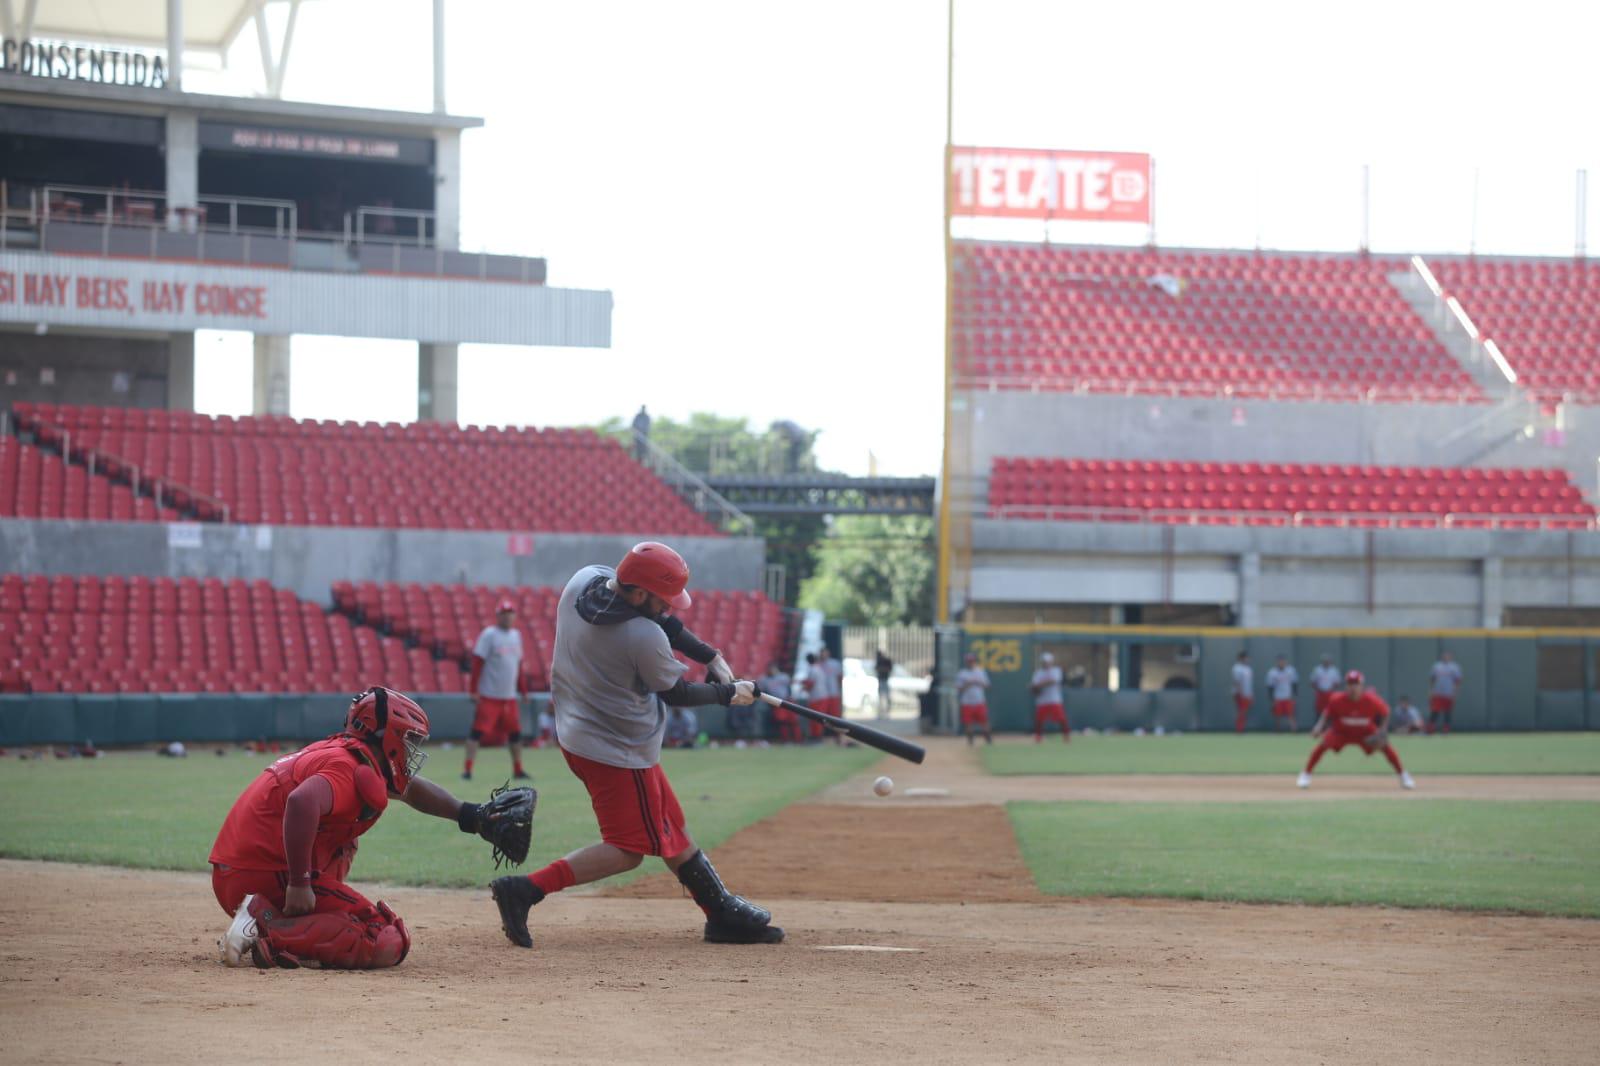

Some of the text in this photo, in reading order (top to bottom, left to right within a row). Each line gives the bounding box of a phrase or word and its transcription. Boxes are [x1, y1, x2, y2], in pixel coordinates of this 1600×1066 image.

[3, 39, 166, 88] CONSENTIDA
[951, 154, 1114, 211] TECATE
[23, 272, 69, 306] HAY
[142, 281, 188, 314] HAY
[194, 283, 267, 319] CONSE
[970, 639, 1021, 672] 325
